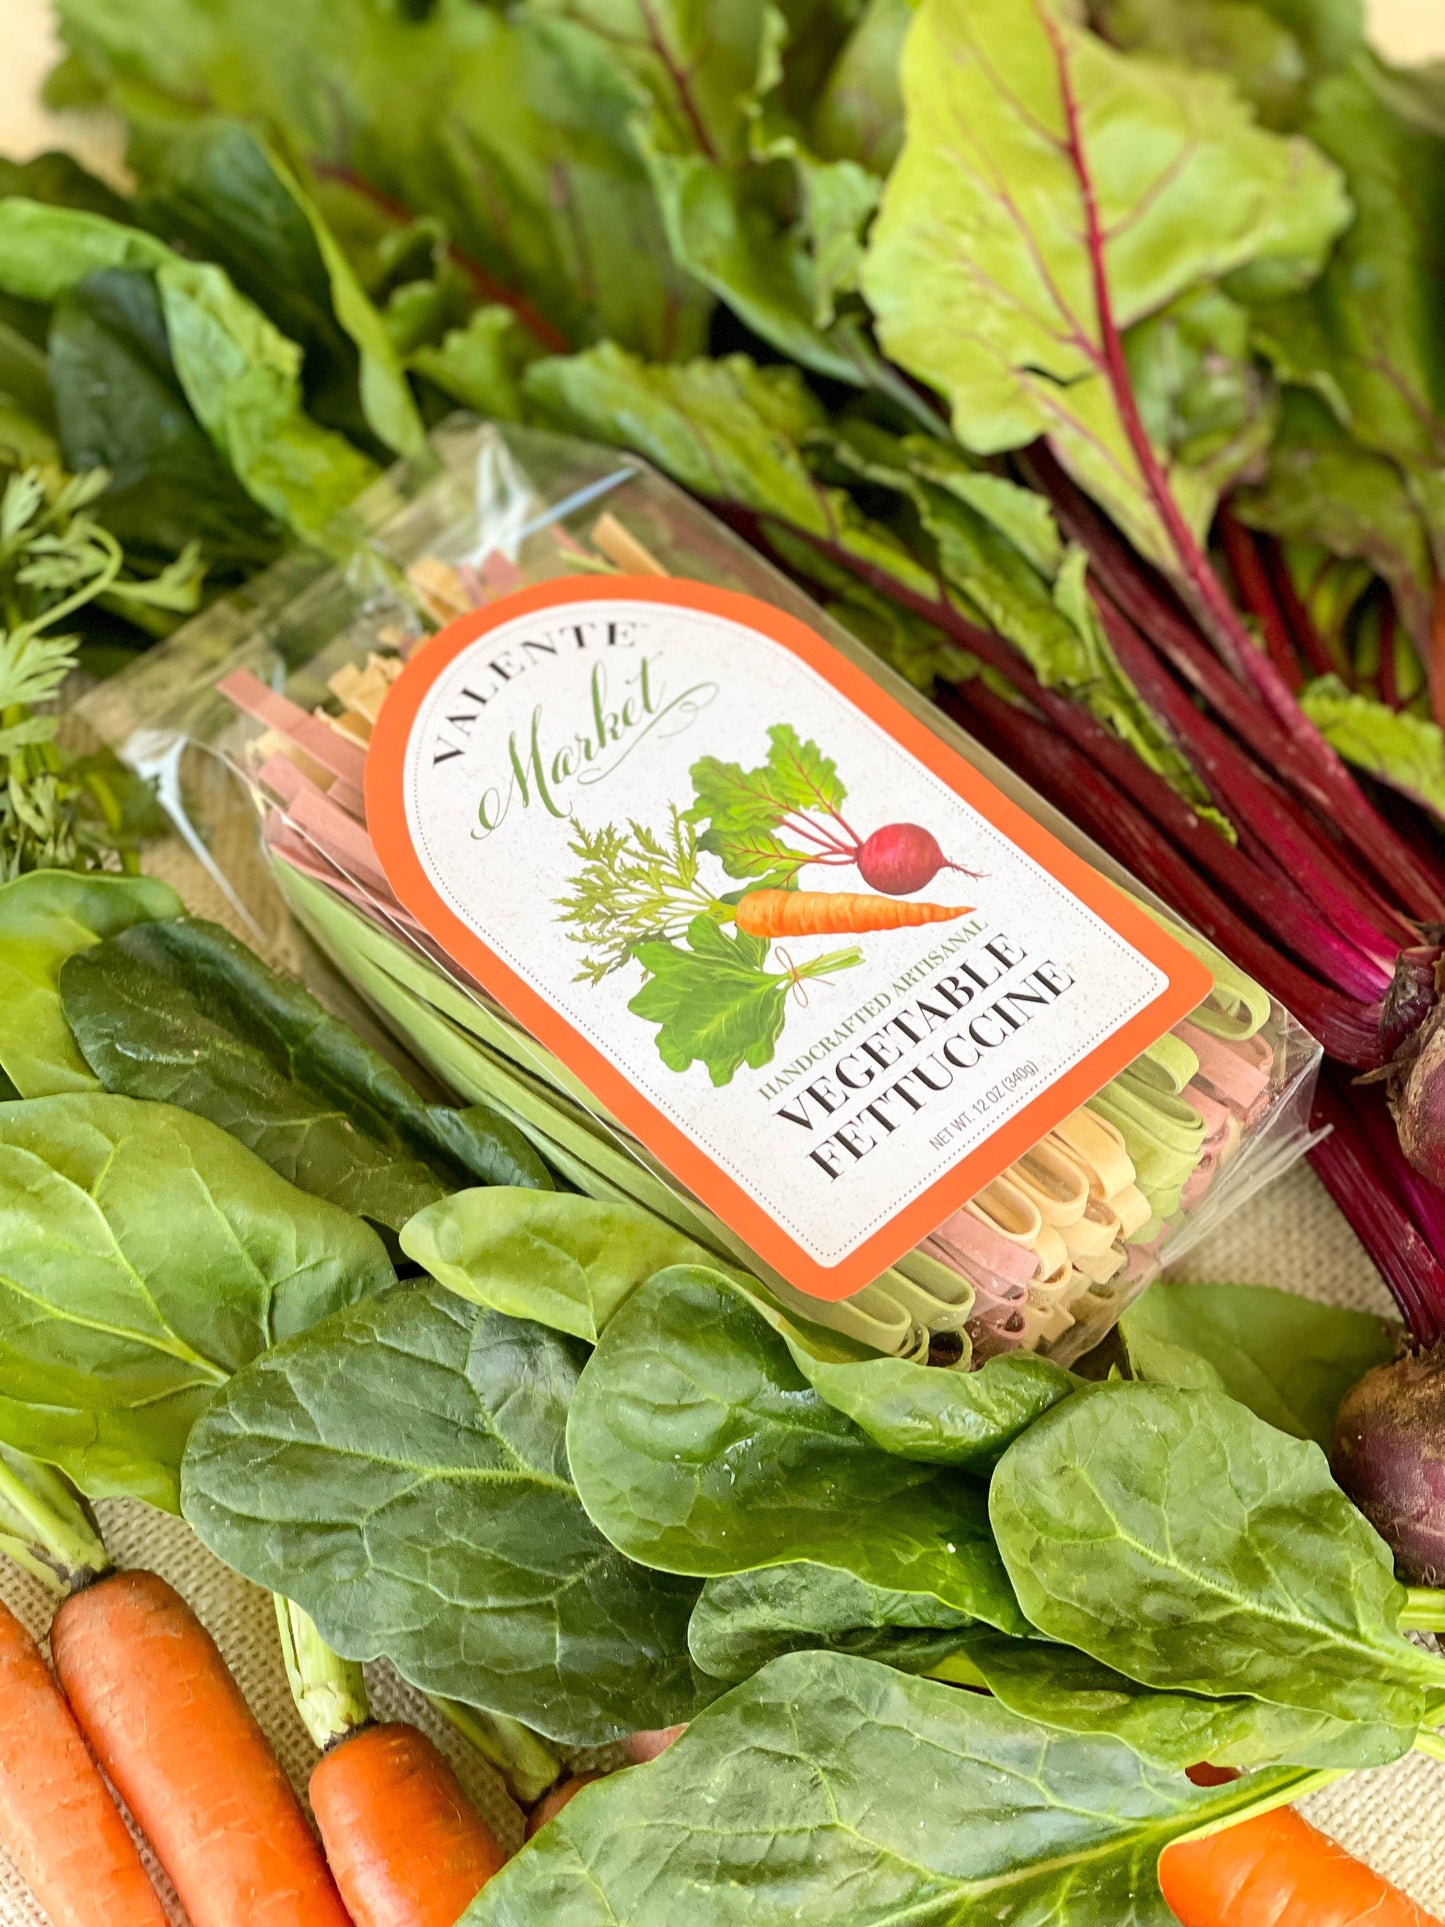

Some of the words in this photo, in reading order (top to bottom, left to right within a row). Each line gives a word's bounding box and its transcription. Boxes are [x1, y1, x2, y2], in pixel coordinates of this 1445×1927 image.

[432, 621, 637, 769] VALENTE
[470, 651, 719, 840] Market
[758, 992, 893, 1102] HANDCRAFTED
[890, 919, 989, 998] ARTISANAL
[772, 932, 1029, 1132] VEGETABLE
[805, 959, 1076, 1184] FETTUCCINE
[929, 1126, 955, 1151] NET
[950, 1111, 976, 1132] WT.
[972, 1098, 991, 1115] 12
[985, 1084, 1006, 1104] OZ
[1001, 1059, 1040, 1093] (340g)
